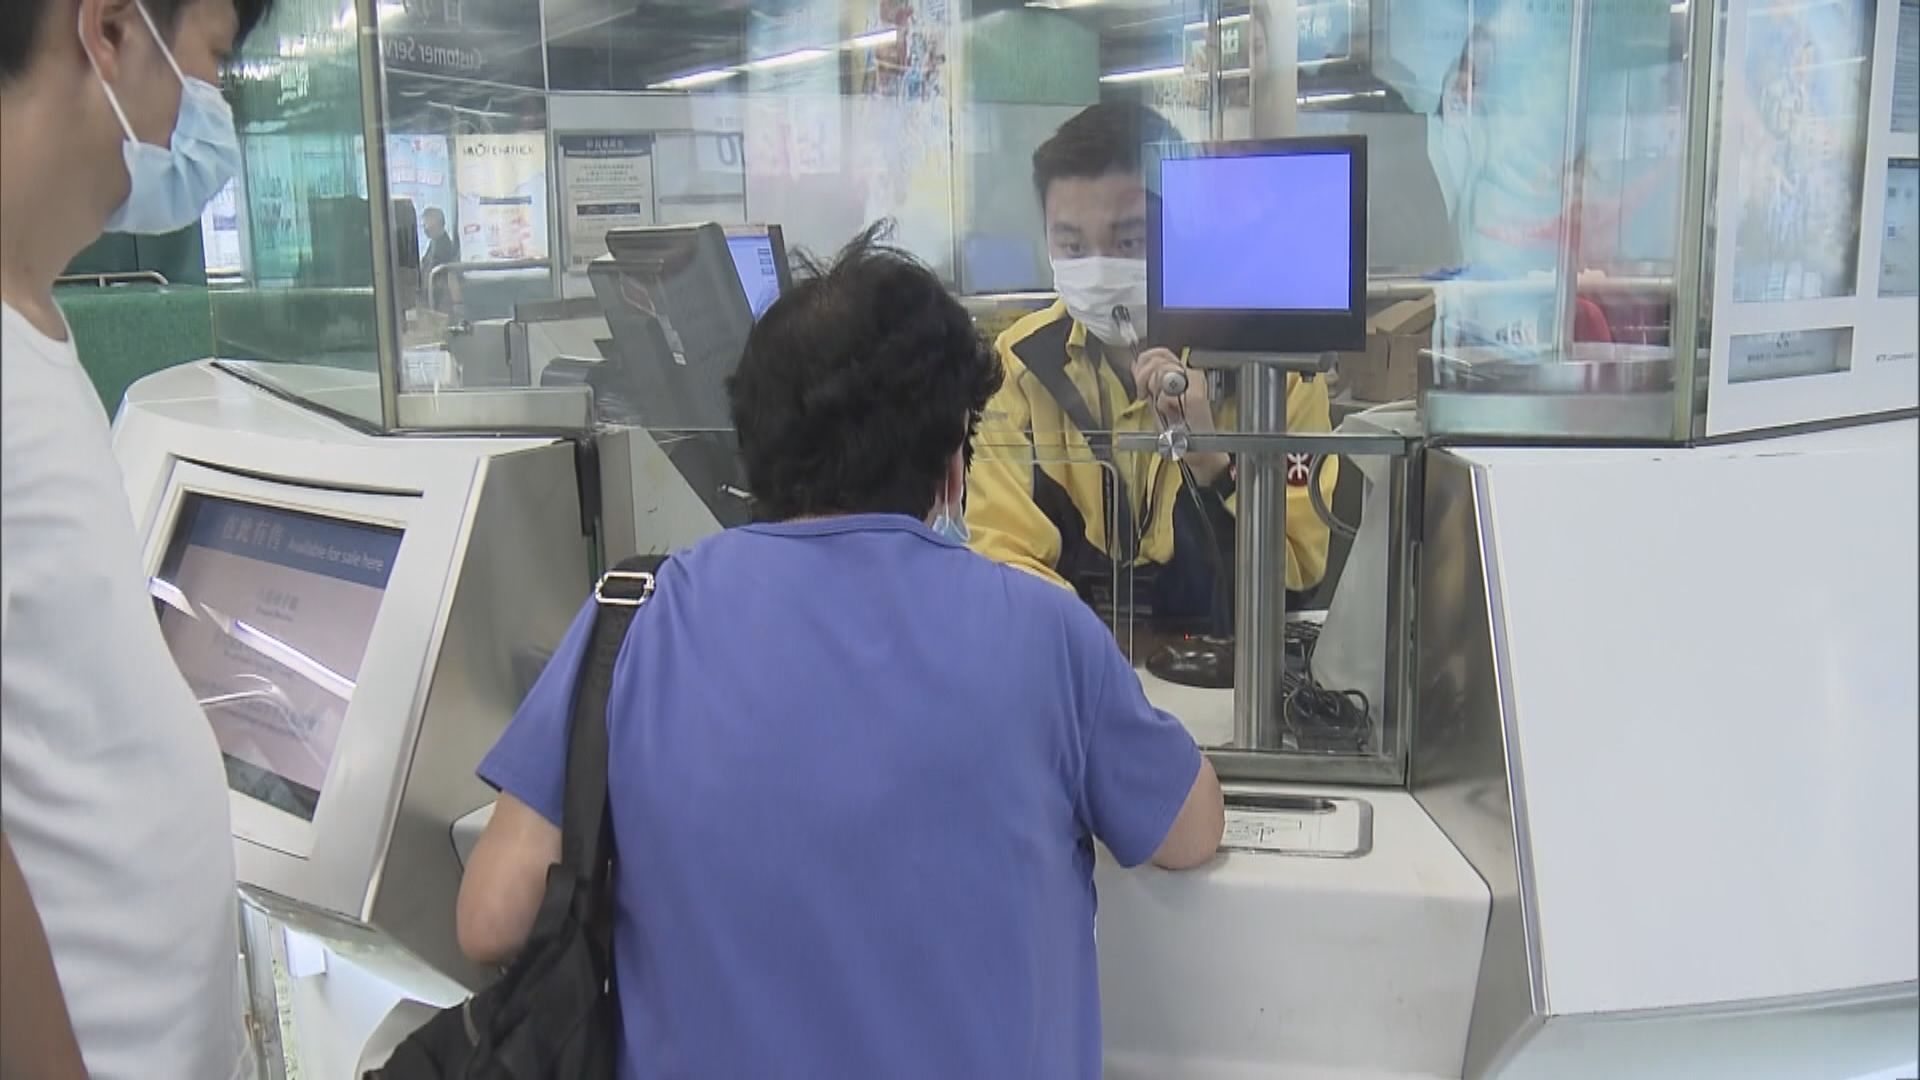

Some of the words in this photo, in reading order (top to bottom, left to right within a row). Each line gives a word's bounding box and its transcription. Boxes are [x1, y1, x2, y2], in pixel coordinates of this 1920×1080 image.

[288, 537, 326, 560] Available
[327, 545, 342, 562] for
[342, 550, 361, 567] sale
[362, 552, 384, 573] here
